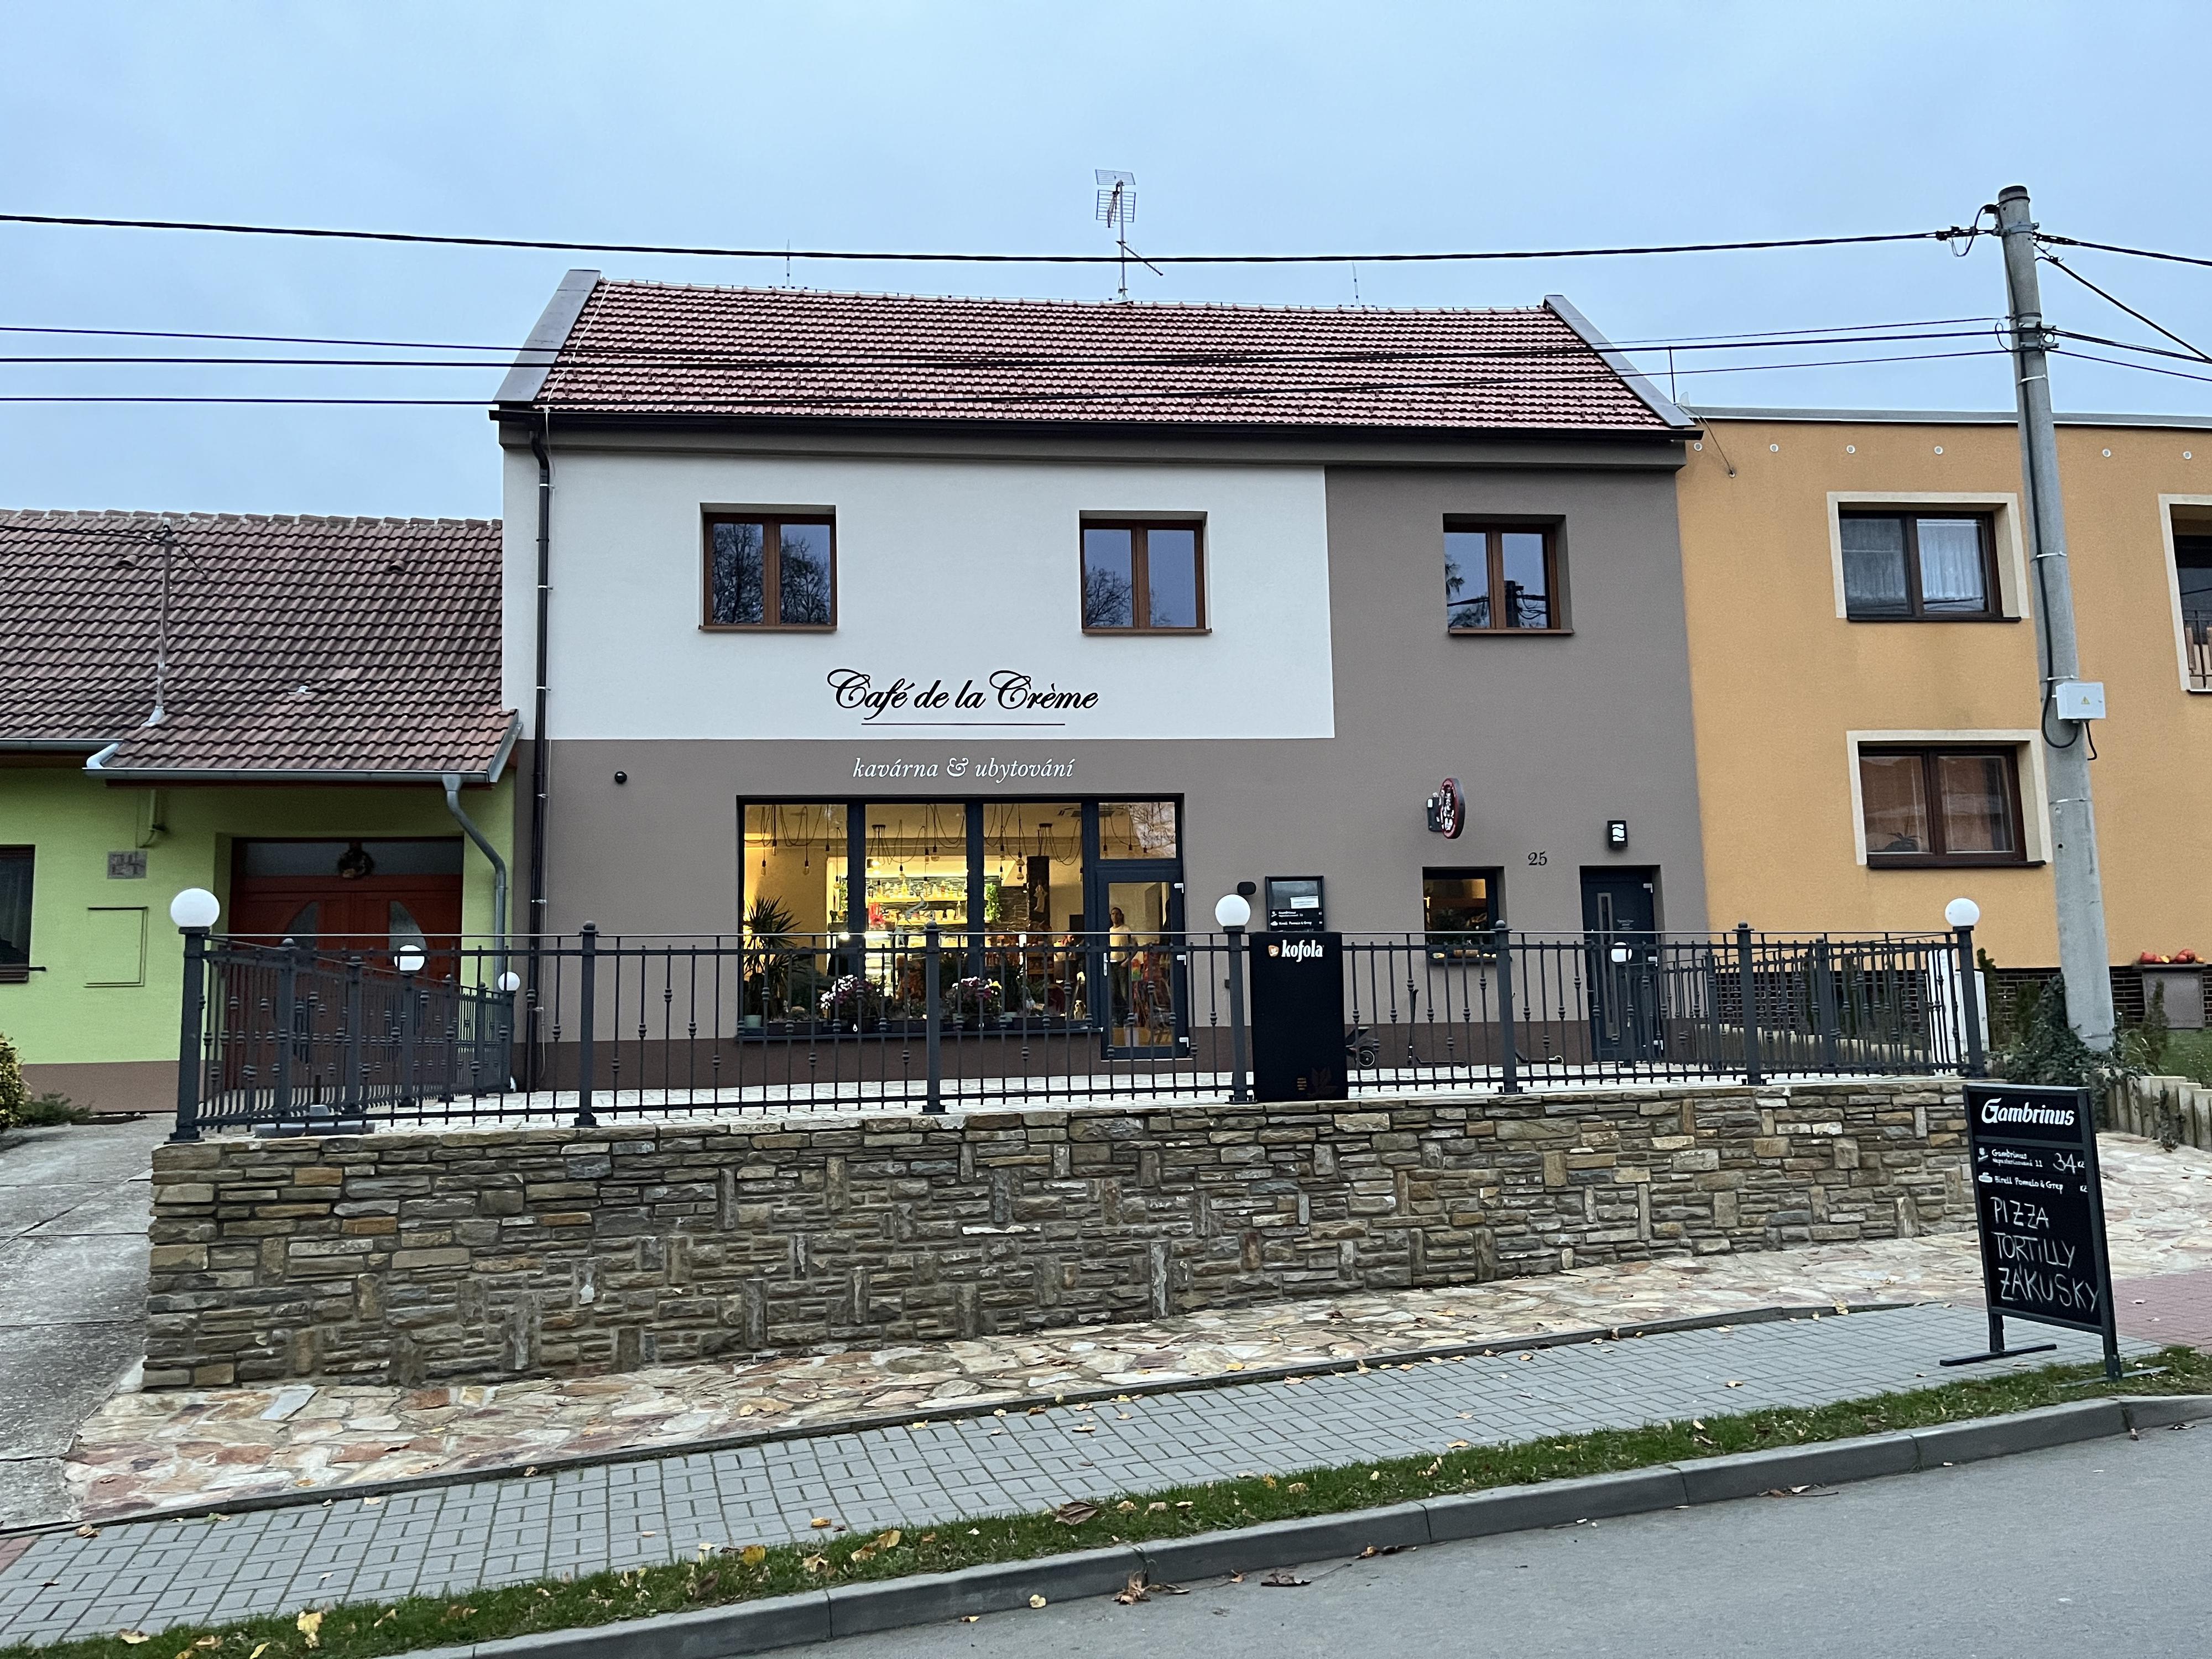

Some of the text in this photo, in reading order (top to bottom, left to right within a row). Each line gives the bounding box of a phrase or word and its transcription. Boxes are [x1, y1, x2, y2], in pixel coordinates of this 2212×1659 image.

[827, 669, 1098, 720] Café de la Crème
[853, 757, 1076, 784] kavárna & ubytování
[1528, 851, 1547, 866] 25
[1281, 939, 1323, 963] kofola
[1981, 1098, 2075, 1126] Gambrinus
[1991, 1148, 2027, 1160] Gambrinus
[2053, 1152, 2077, 1174] 34
[1990, 1196, 2049, 1229] PIZZA
